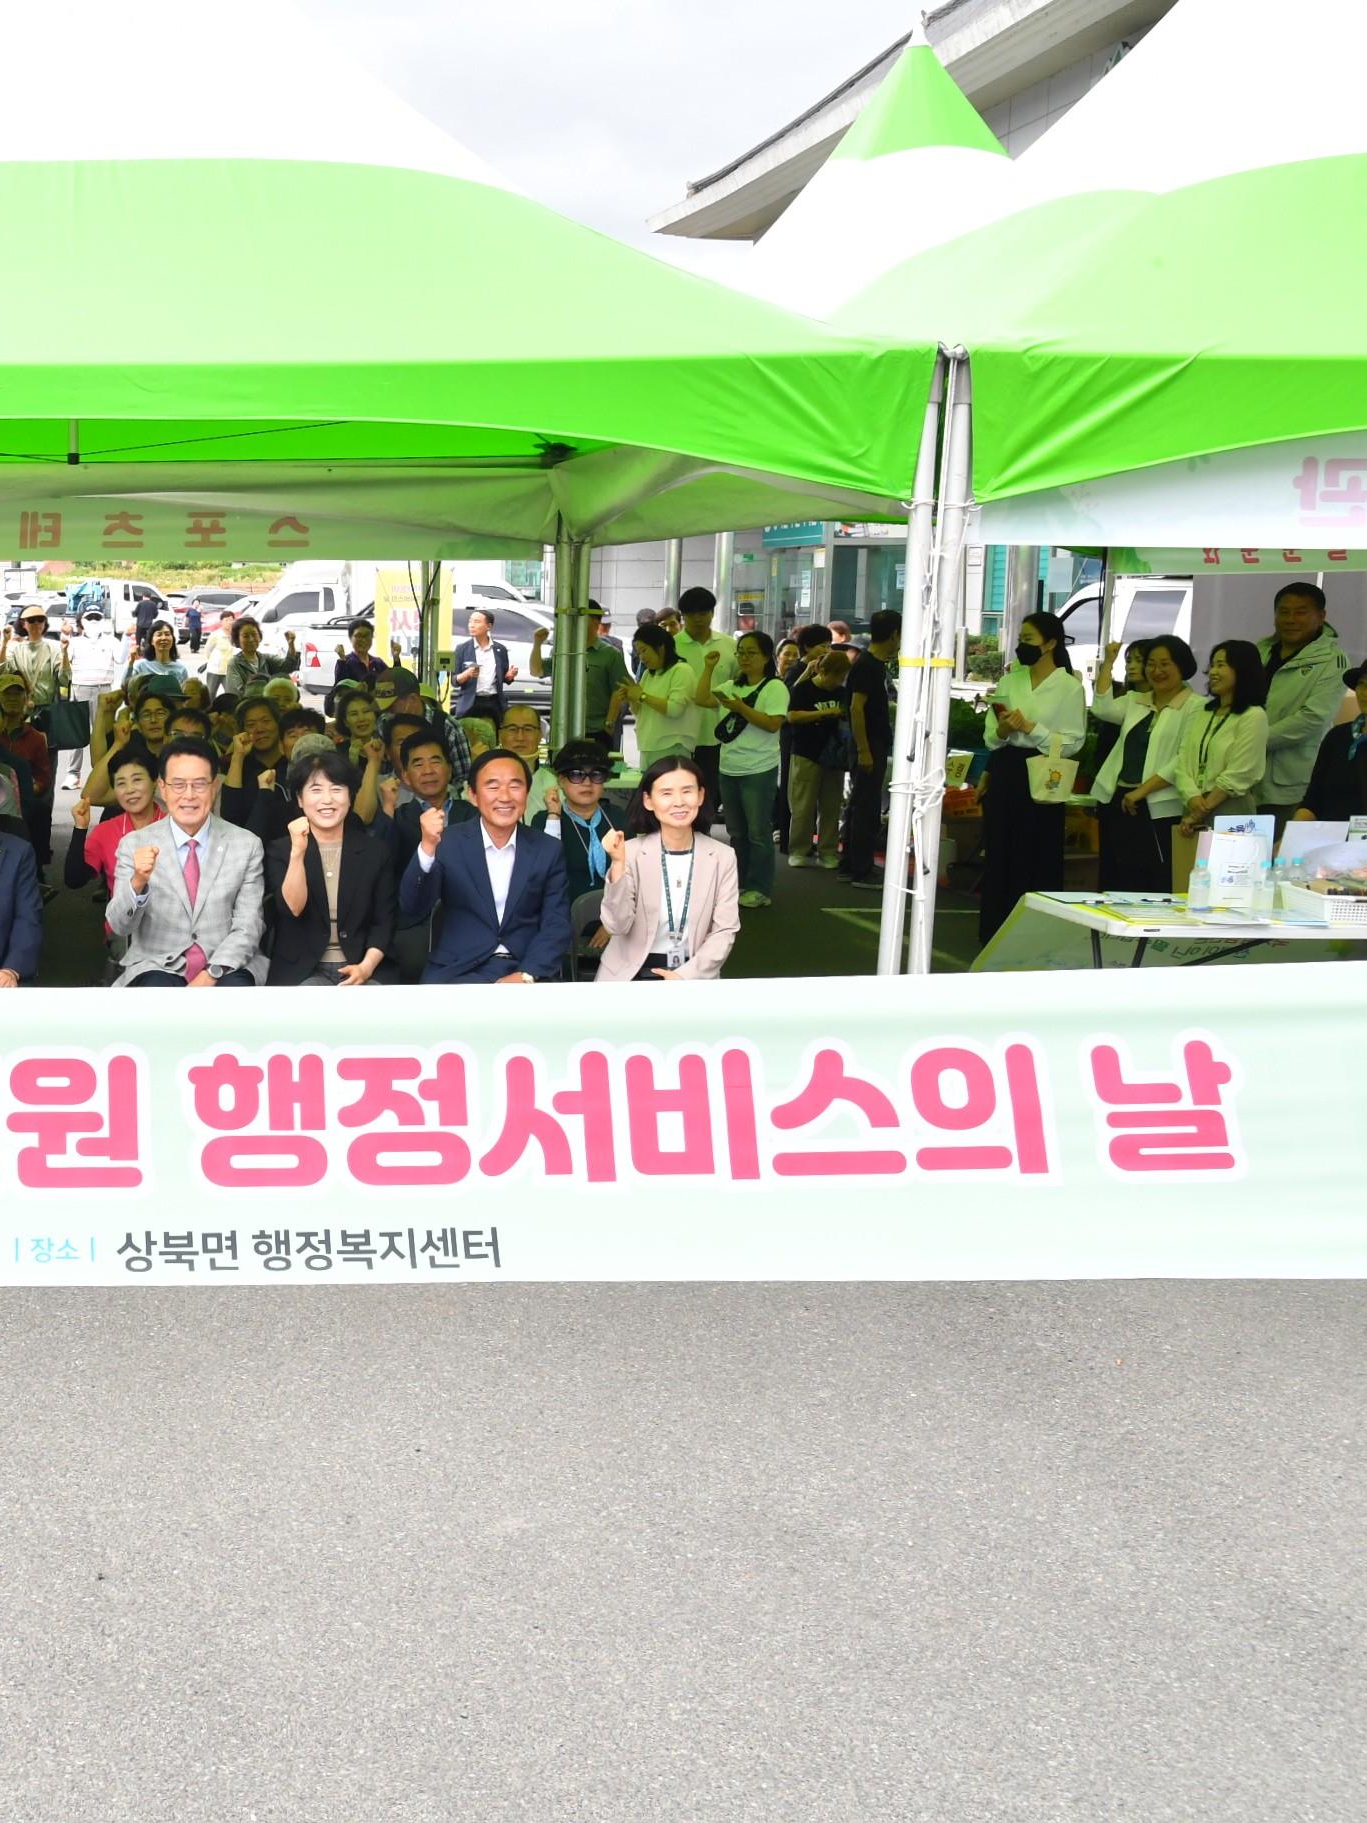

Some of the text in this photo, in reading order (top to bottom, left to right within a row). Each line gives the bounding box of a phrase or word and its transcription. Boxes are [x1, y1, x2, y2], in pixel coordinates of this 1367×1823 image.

[187, 1043, 1051, 1190] 행정서비스의
[1089, 1039, 1238, 1173] 날
[31, 1236, 80, 1264] 장소
[117, 1231, 240, 1272] 상북면
[251, 1228, 503, 1272] 행정복지센터
